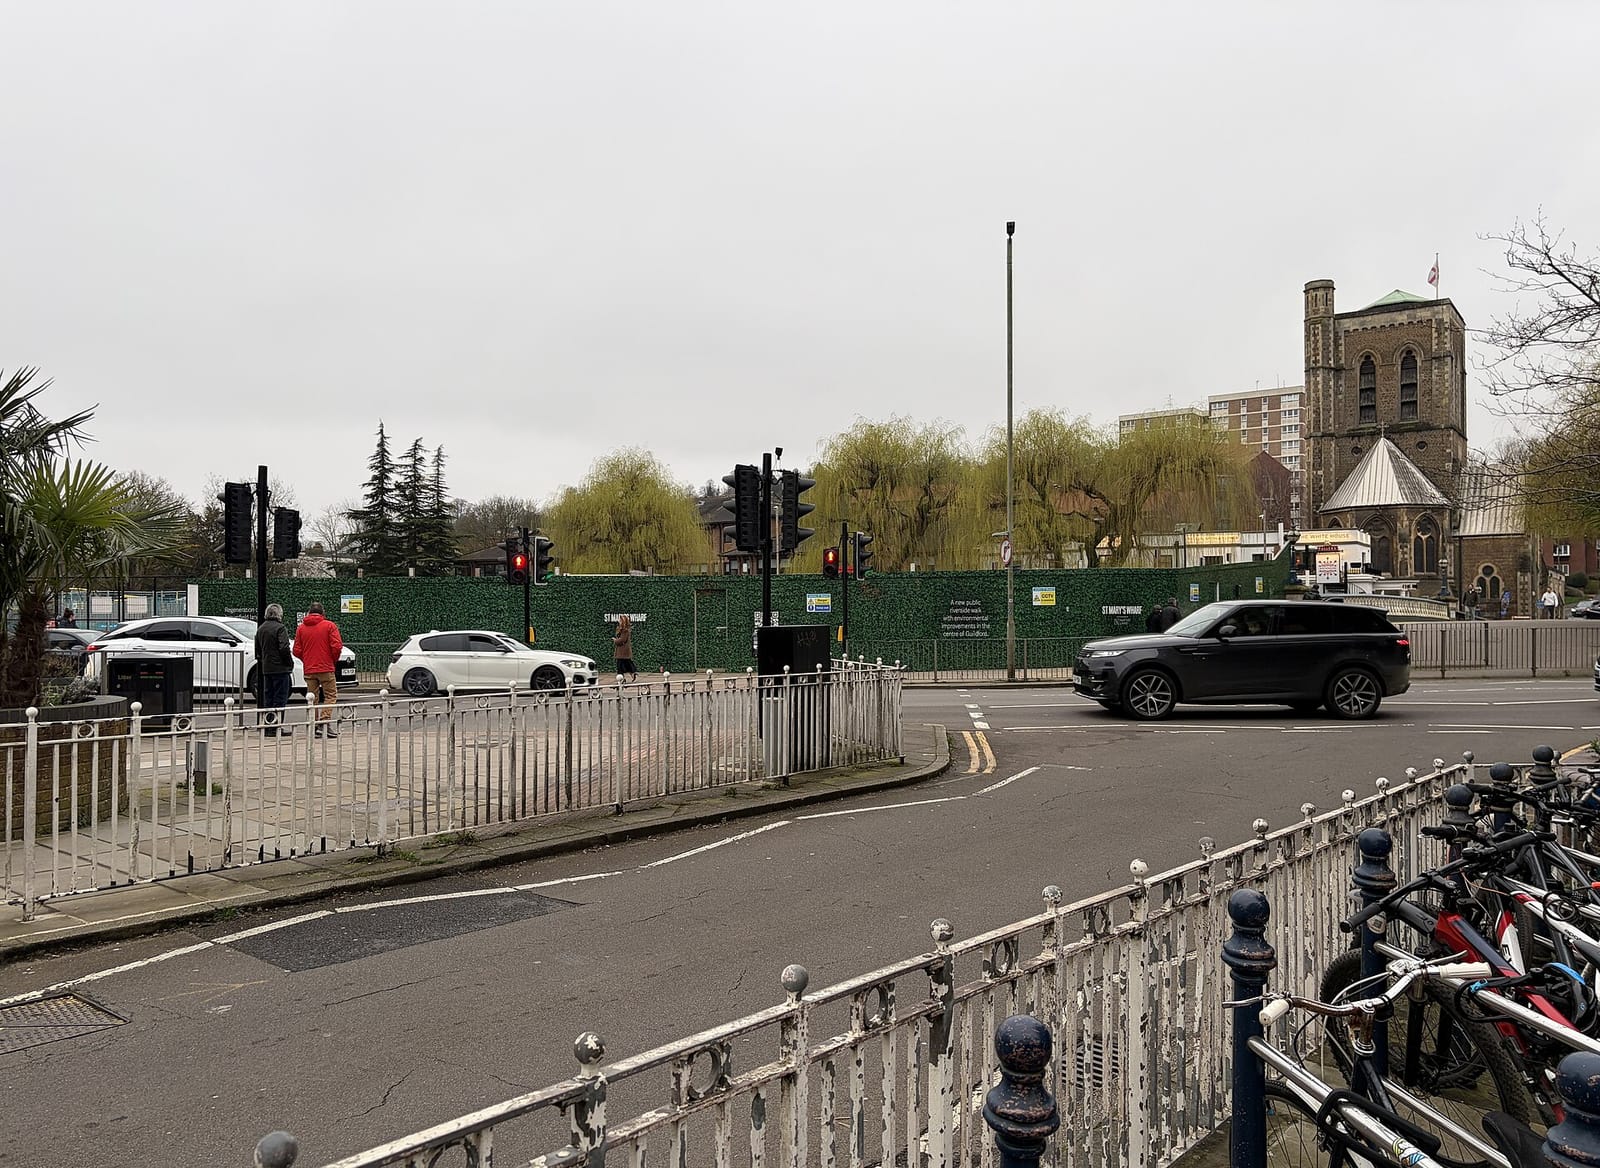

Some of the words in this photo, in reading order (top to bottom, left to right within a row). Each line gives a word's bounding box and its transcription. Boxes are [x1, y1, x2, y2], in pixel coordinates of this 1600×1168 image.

[1102, 606, 1108, 614] ST
[1109, 606, 1126, 614] MARY'S
[1127, 606, 1142, 614] WHARF
[604, 613, 611, 622] ST
[630, 613, 648, 622] WHARF
